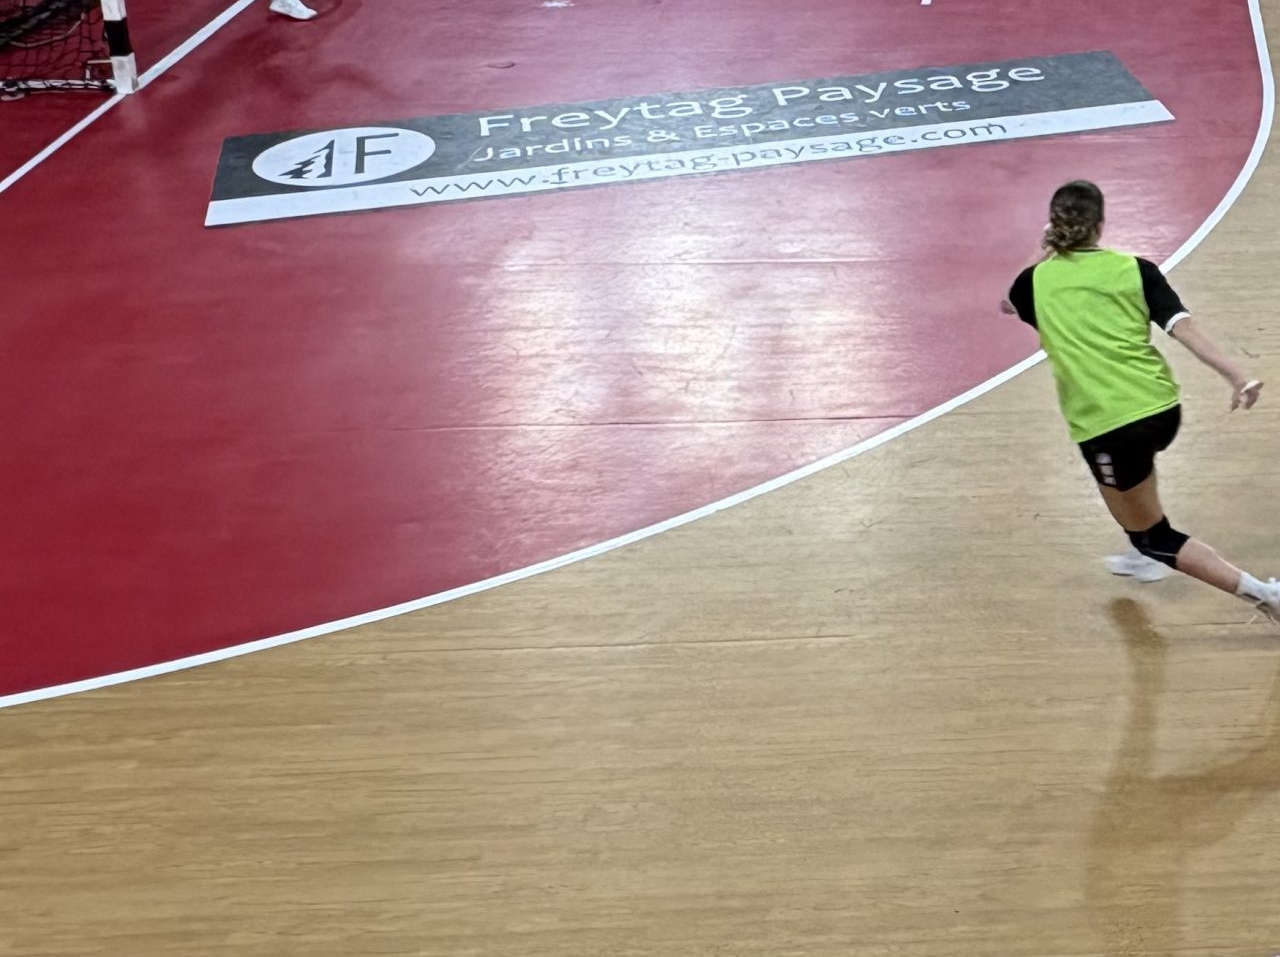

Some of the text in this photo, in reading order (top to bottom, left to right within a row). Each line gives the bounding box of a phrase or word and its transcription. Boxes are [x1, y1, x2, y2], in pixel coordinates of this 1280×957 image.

[471, 97, 971, 163] Jardins & Espaces verts
[478, 66, 1045, 136] Freytag Paysage
[410, 123, 1007, 197] www.freytag-paysage.com
